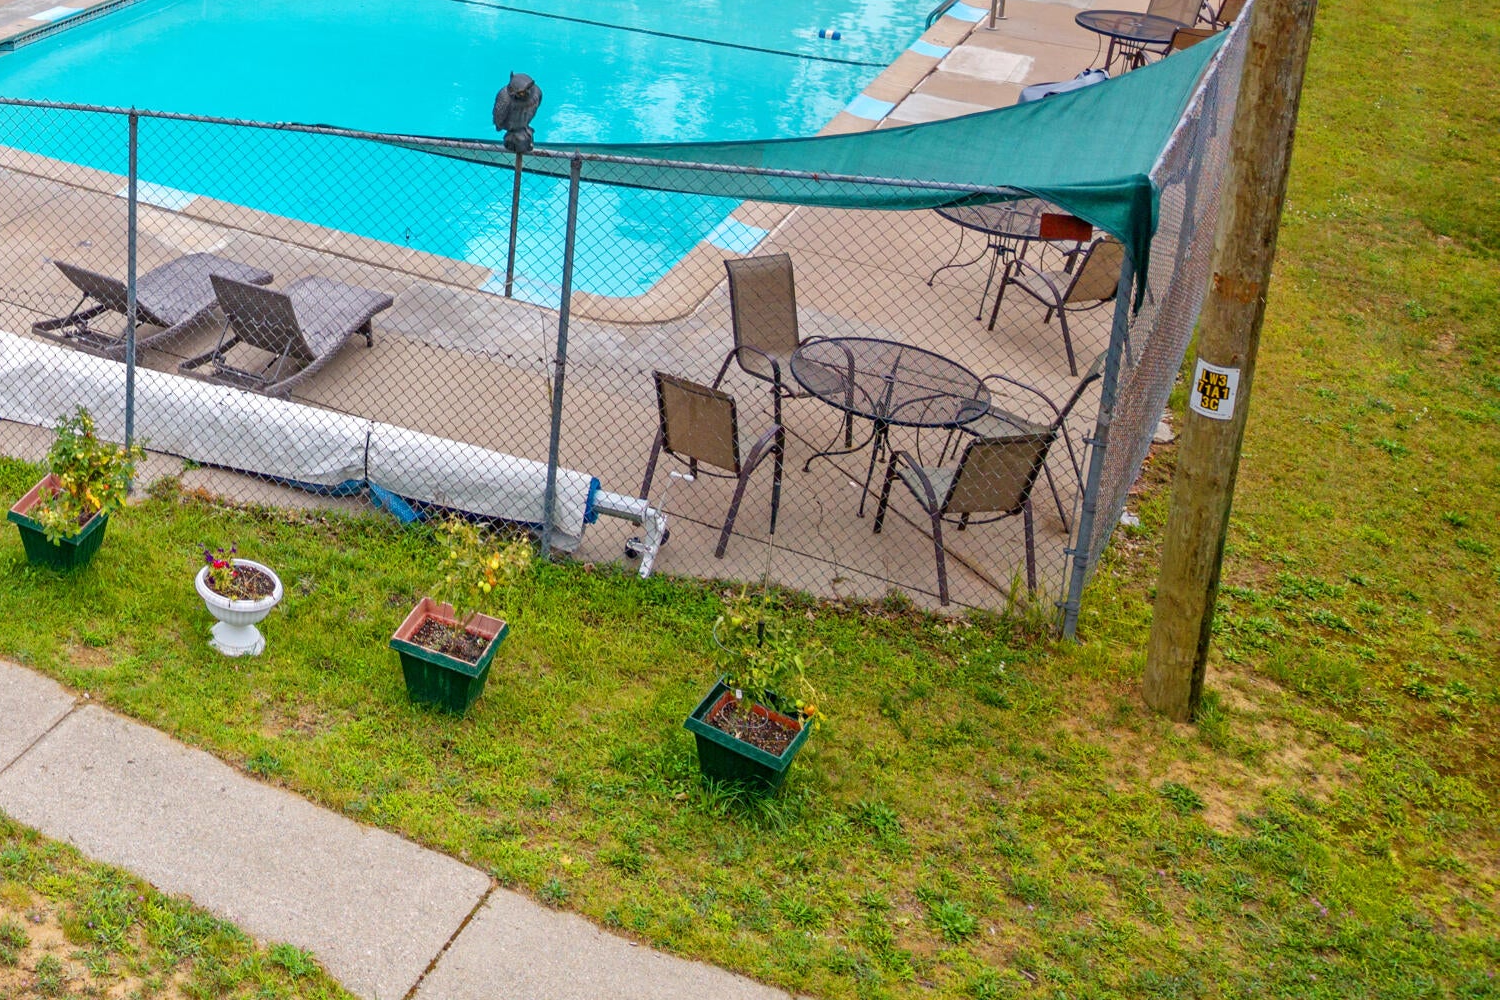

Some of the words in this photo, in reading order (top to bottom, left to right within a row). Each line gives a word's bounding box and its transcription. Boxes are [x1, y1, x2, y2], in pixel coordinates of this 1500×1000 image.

[1202, 370, 1227, 387] LW3
[1199, 380, 1229, 399] 71A1
[1201, 396, 1218, 410] 3C
